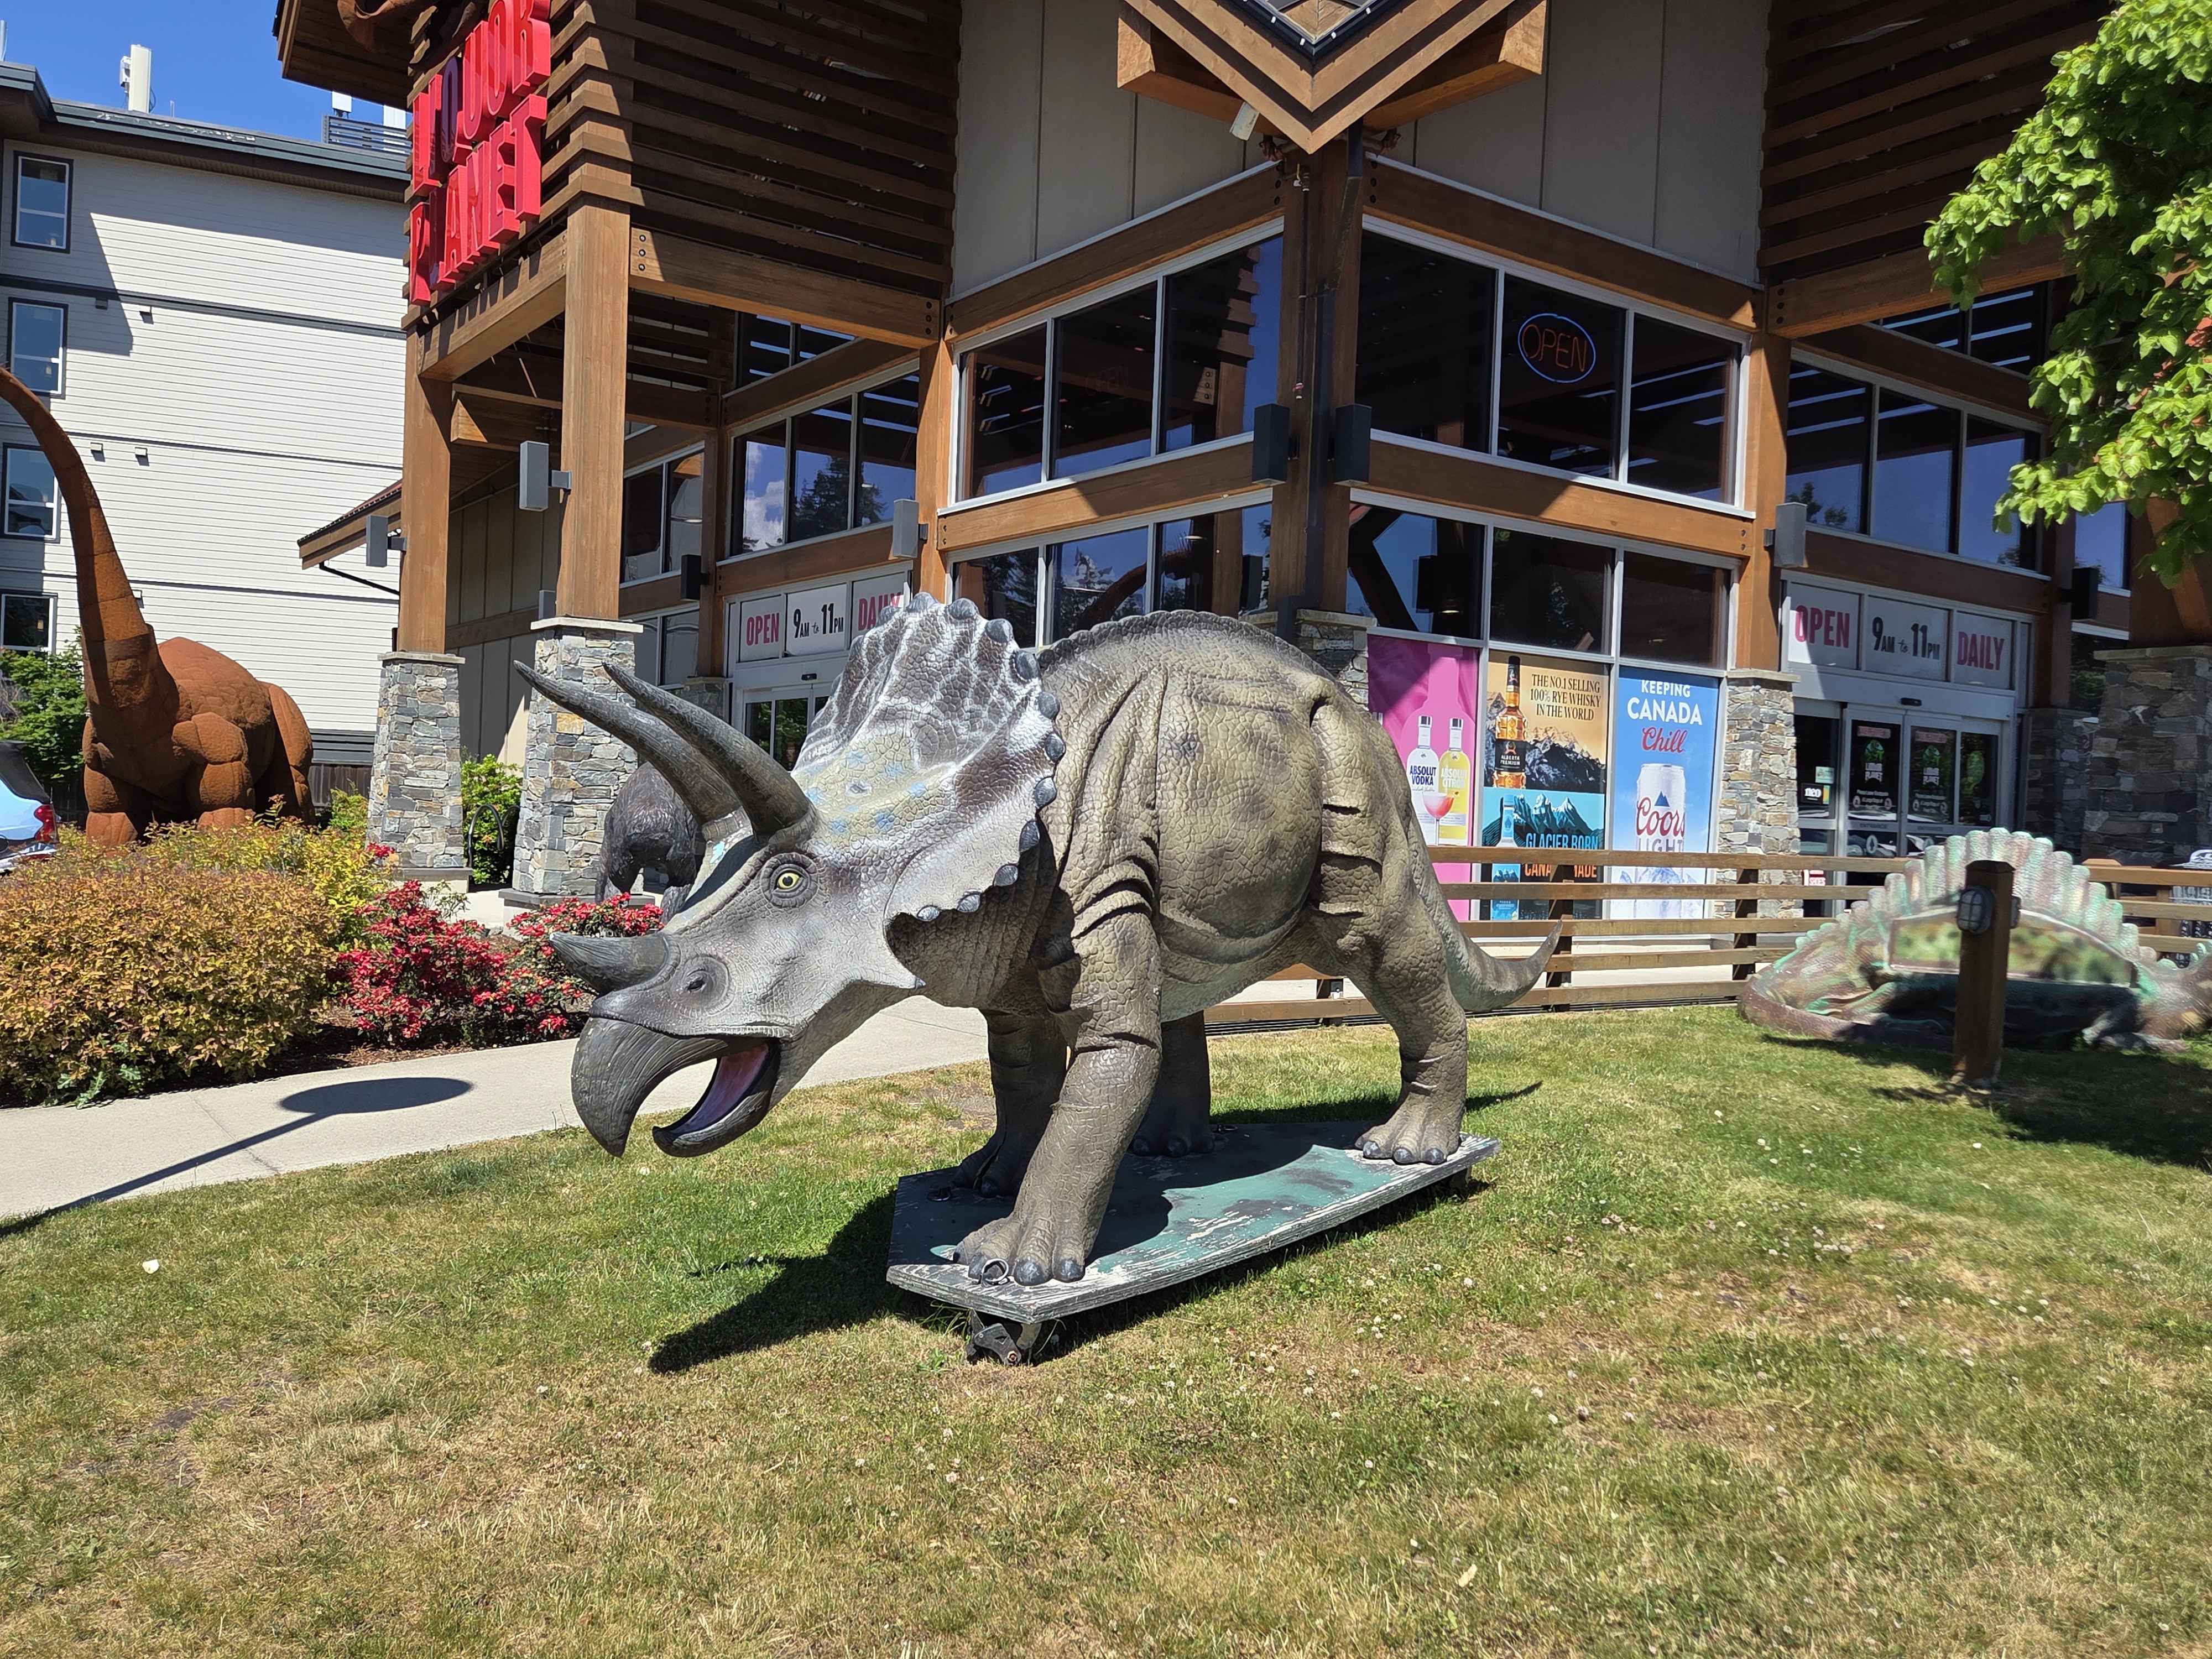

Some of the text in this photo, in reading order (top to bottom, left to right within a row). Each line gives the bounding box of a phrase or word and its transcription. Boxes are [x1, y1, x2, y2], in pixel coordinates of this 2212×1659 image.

[410, 93, 547, 304] PLANET
[1522, 324, 1588, 372] OPEN
[747, 613, 780, 646] OPEN
[794, 609, 810, 638] 9AM
[812, 623, 819, 634] to
[821, 603, 844, 634] 11PM
[1794, 604, 2005, 671] OPEN 9AM to 11PM DAILY
[1532, 674, 1600, 693] THE NO.1 SELLING
[1641, 680, 1691, 698] KEEPING
[1530, 688, 1601, 707] 100% RYE WHISKY
[1536, 703, 1594, 721] IN THE WORLD
[1627, 697, 1703, 726] CANADA
[1642, 727, 1688, 753] Chill
[1410, 765, 1437, 776] ABSOLUT
[1411, 775, 1433, 785] VODKA
[1636, 796, 1686, 838] Coors
[1526, 833, 1598, 850] GLACIER BORN
